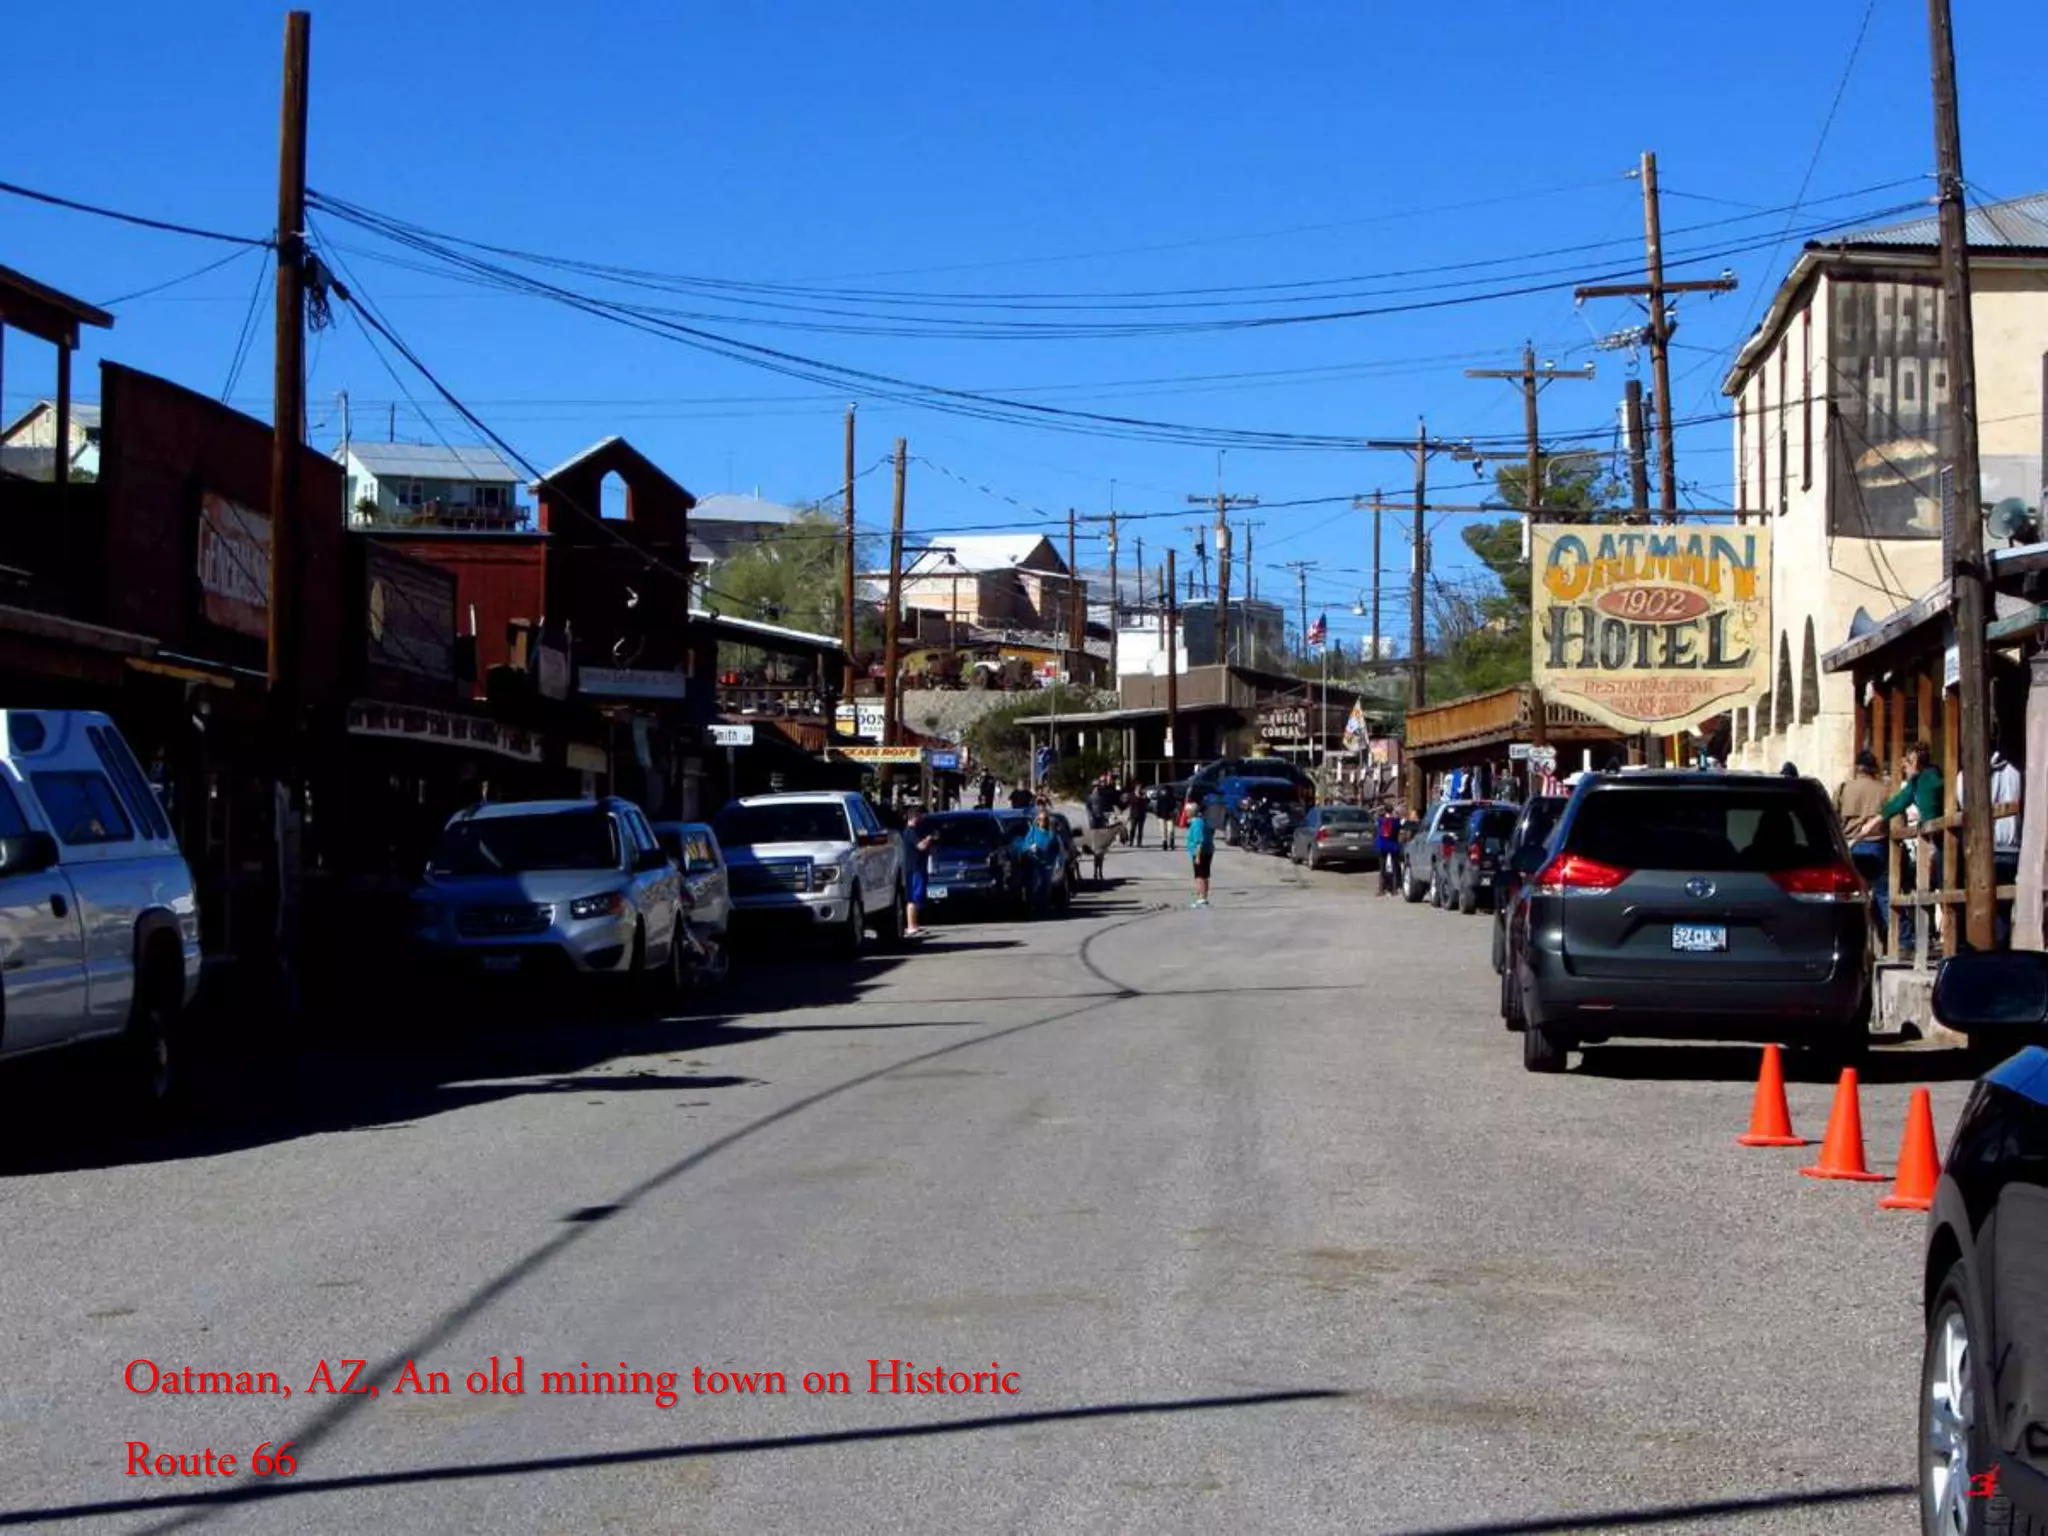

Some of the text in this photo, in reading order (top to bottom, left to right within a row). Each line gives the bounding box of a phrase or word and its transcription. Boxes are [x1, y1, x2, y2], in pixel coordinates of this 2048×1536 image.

[1837, 357, 1949, 414] SHOP
[1543, 534, 1755, 602] OATMAN
[1621, 589, 1687, 615] 1902
[1543, 605, 1753, 670] HOTEL
[713, 728, 738, 741] mith
